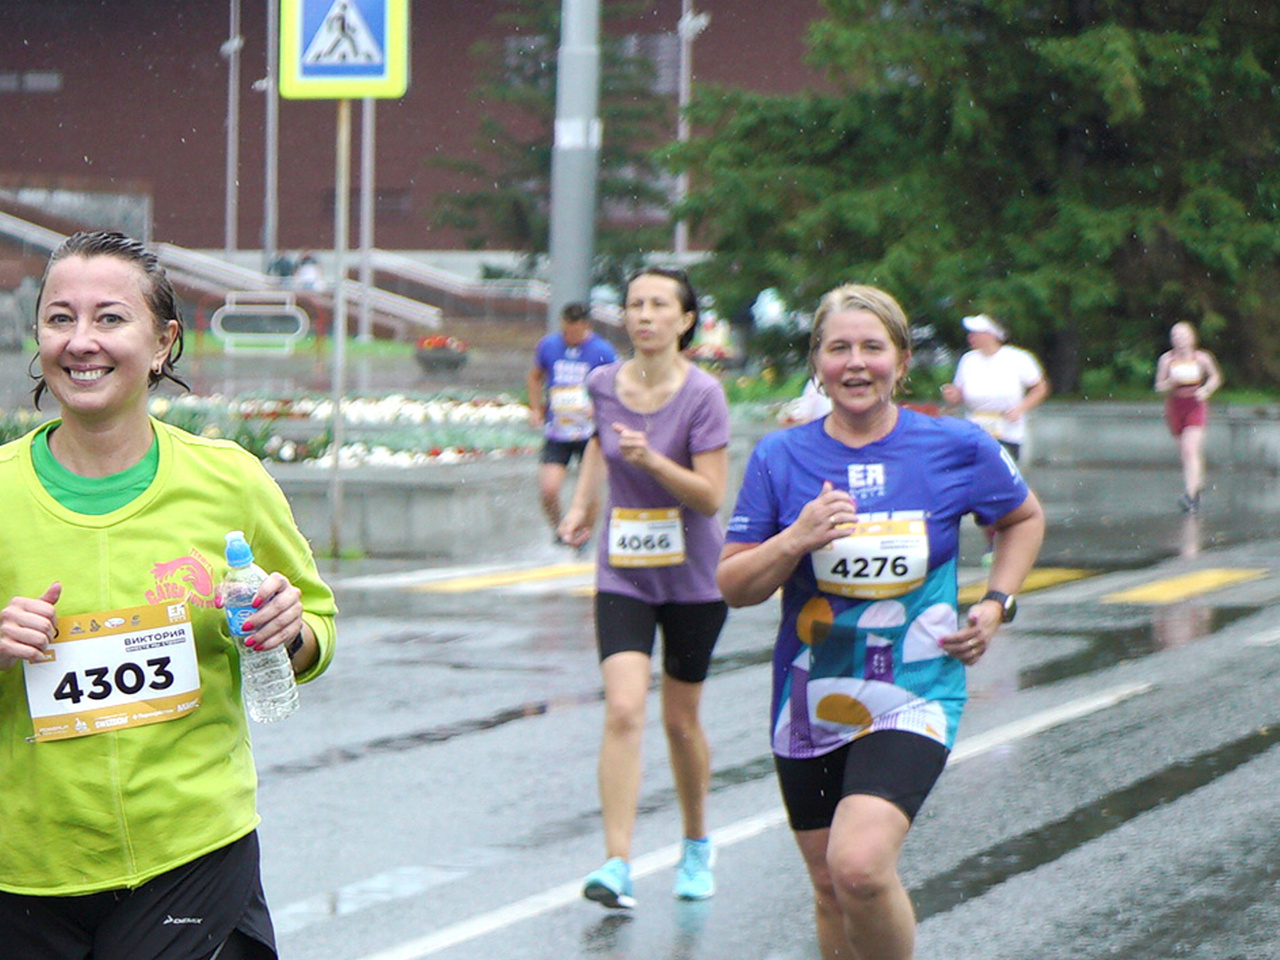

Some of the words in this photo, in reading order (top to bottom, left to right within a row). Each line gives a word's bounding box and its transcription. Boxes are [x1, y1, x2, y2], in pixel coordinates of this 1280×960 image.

[616, 533, 672, 551] 4066
[830, 556, 909, 578] 4276
[124, 628, 186, 646] ВИКТОРИЯ
[53, 656, 175, 705] 4303
